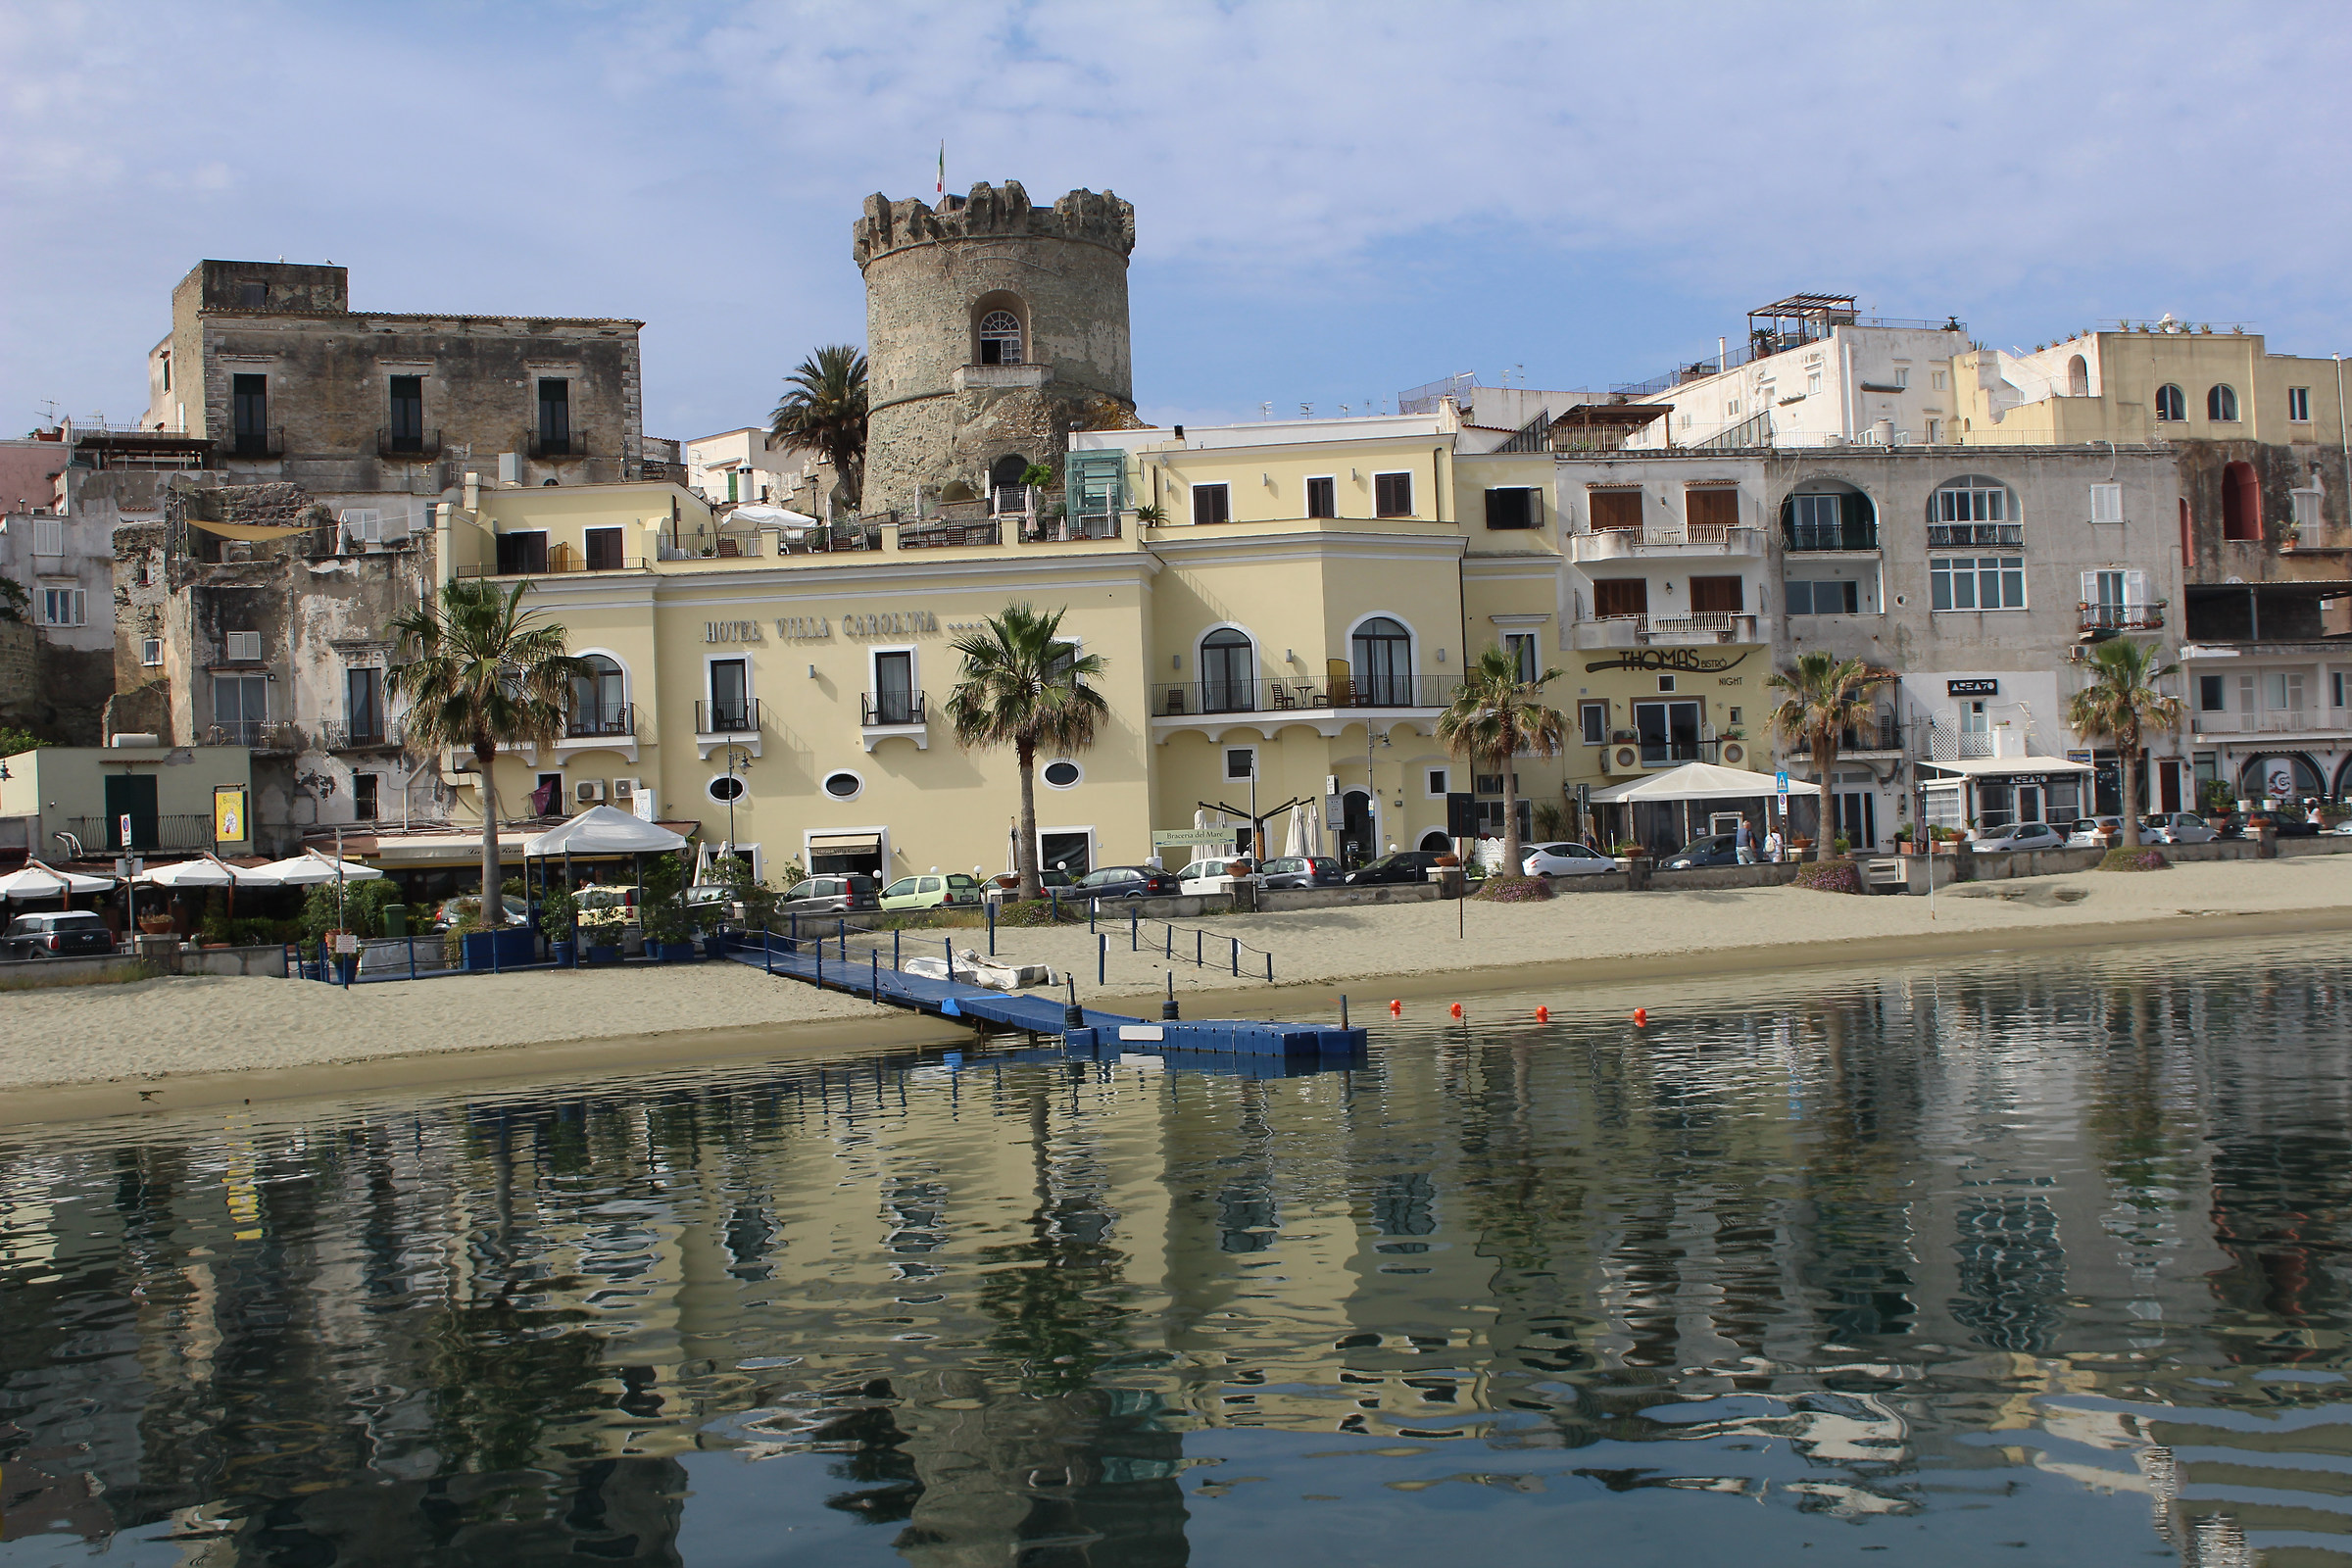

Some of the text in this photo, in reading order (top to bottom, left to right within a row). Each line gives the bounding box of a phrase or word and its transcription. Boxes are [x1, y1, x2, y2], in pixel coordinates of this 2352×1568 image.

[705, 610, 938, 643] HOTEL VILLA CAROLINA
[1619, 649, 1700, 671] THOMAS
[1718, 676, 1742, 686] NIGHT
